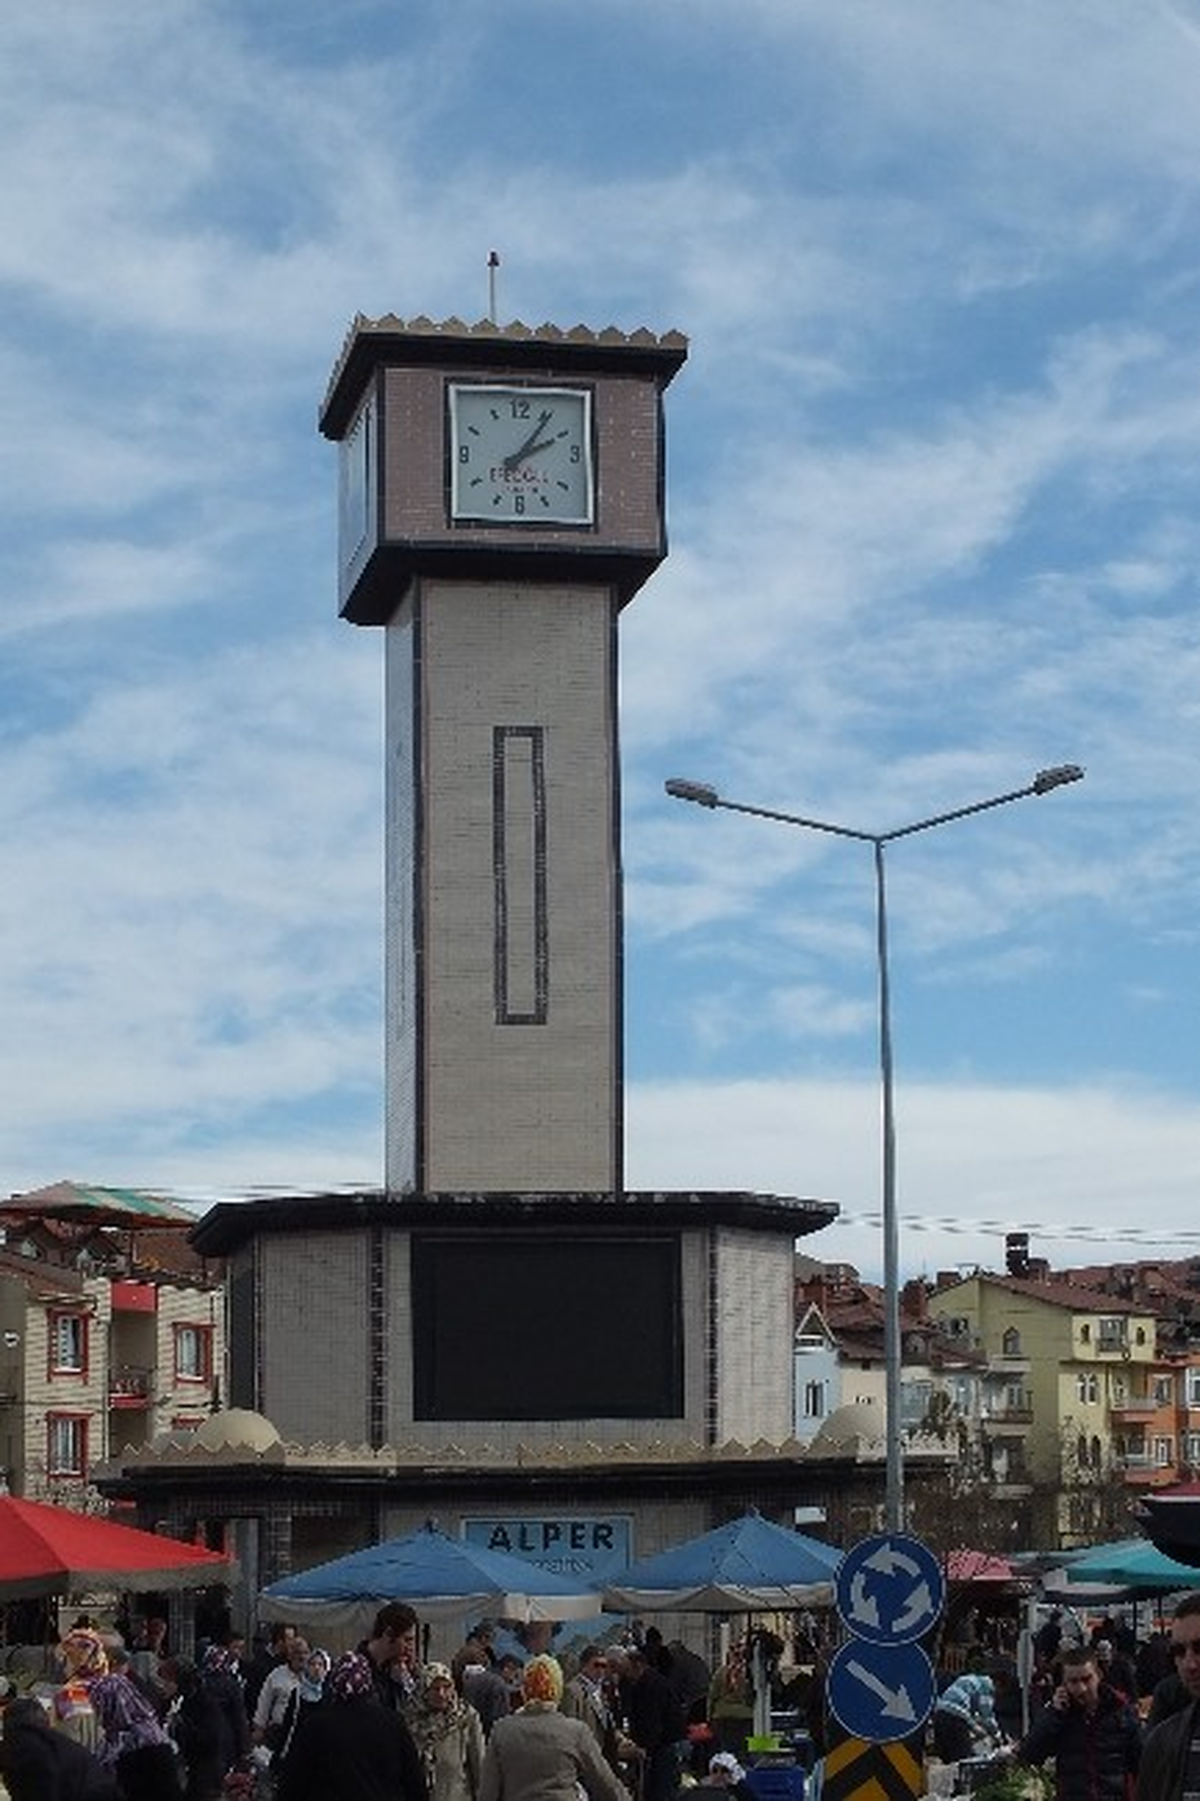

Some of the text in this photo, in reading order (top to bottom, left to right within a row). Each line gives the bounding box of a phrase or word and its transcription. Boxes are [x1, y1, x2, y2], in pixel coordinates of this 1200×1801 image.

[510, 400, 530, 419] 12
[570, 446, 580, 464] 3
[514, 495, 525, 515] 6
[488, 1522, 613, 1551] ALPER
